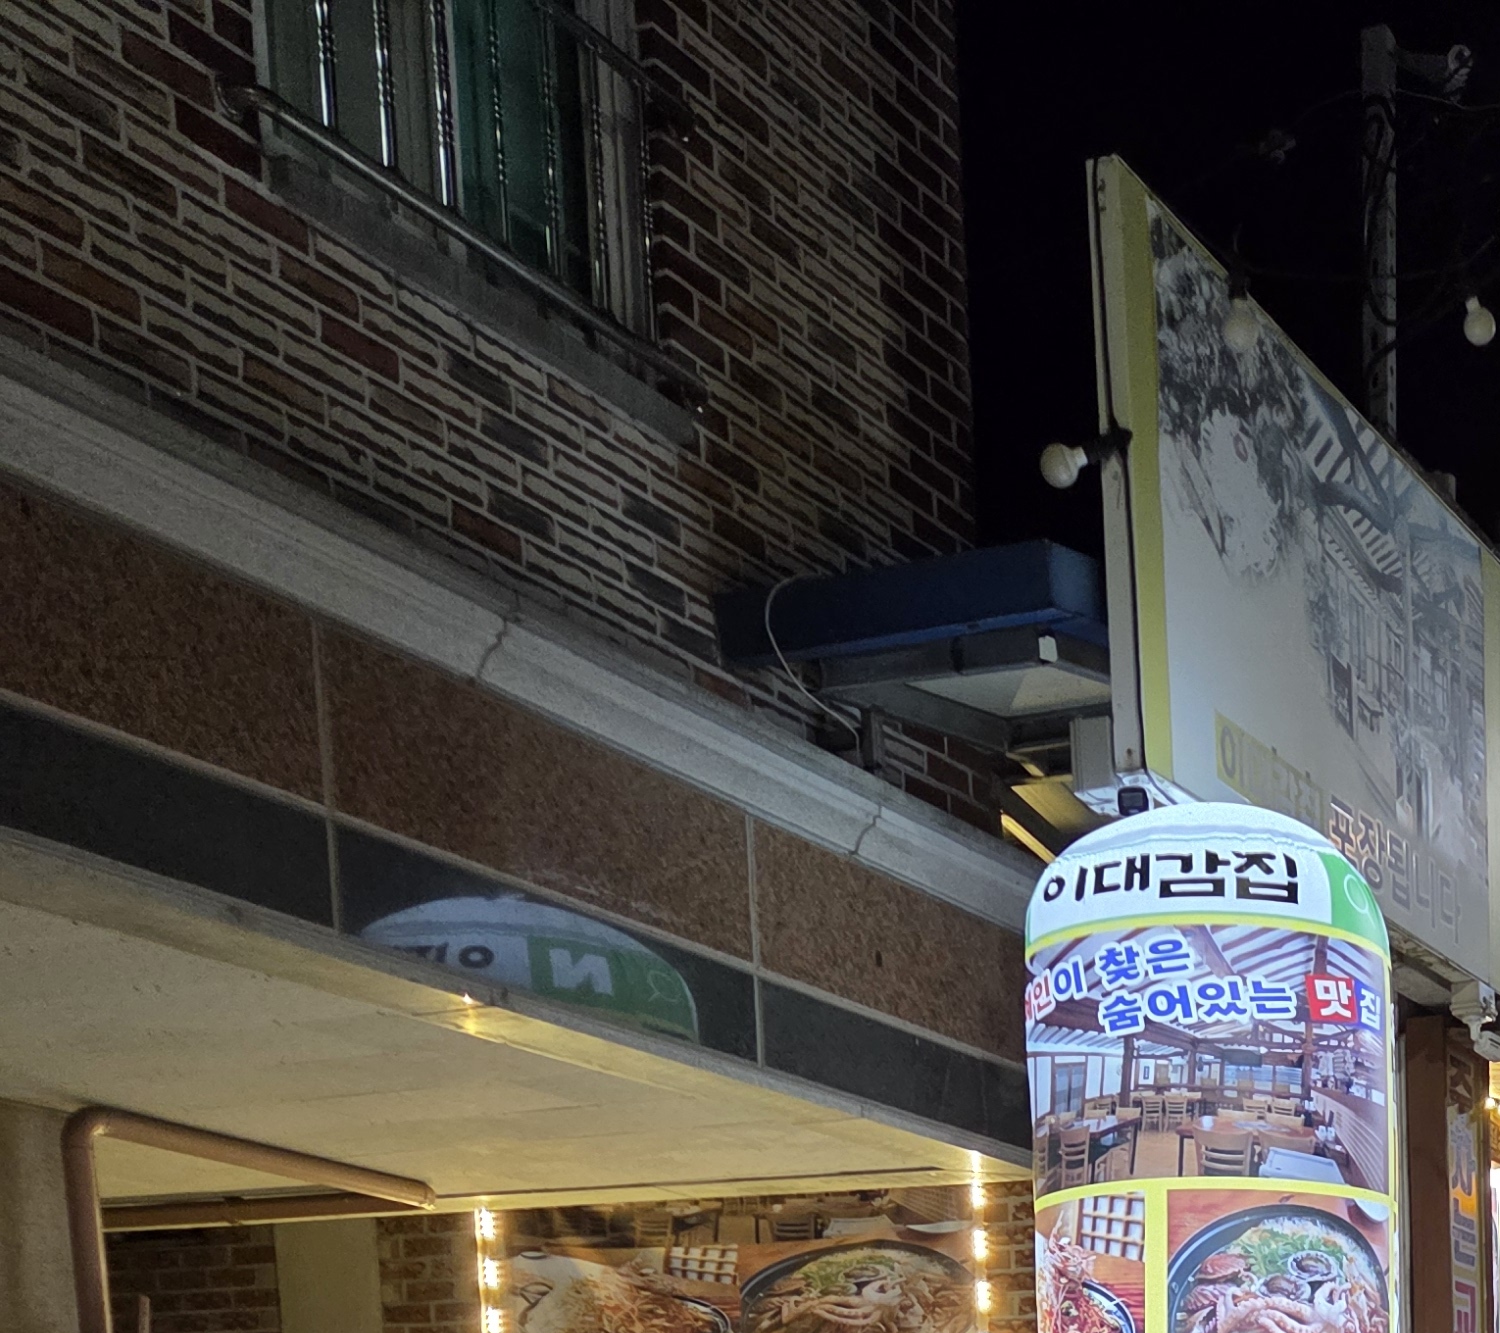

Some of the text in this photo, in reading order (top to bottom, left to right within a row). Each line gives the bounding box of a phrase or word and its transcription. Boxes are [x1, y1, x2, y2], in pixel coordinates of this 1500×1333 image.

[1042, 849, 1299, 905] 이대감집
[1330, 793, 1463, 945] 포장됩니다
[1102, 978, 1382, 1030] 숨어있는 맛집
